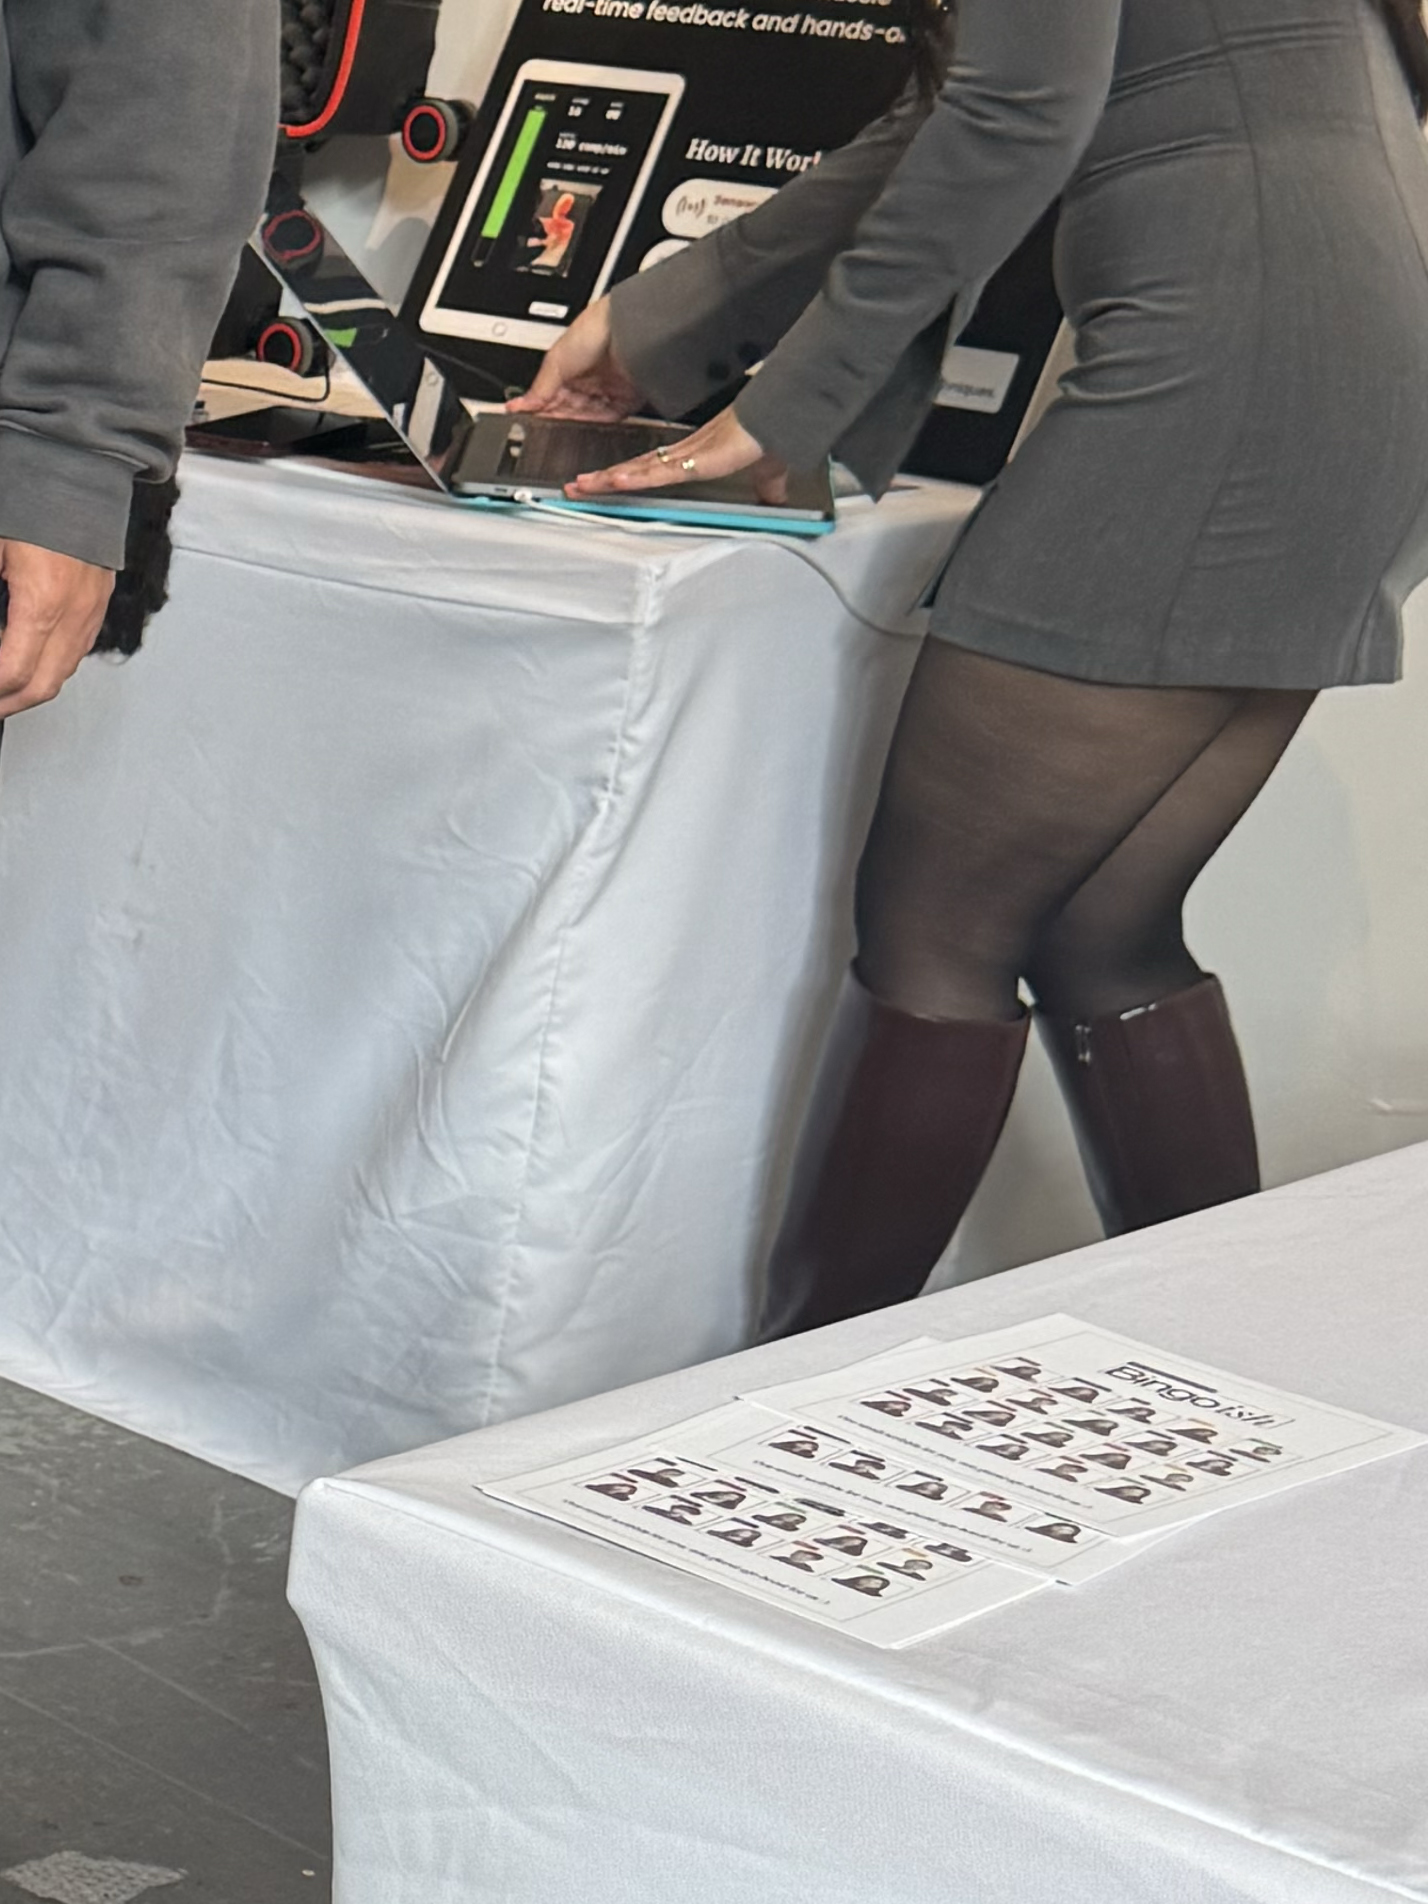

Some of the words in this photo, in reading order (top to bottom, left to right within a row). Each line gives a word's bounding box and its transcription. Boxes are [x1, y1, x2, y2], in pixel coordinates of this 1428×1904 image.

[645, 0, 751, 29] feedback
[751, 11, 801, 34] and
[800, 13, 906, 44] hands-o
[685, 137, 740, 165] How
[739, 144, 762, 167] It
